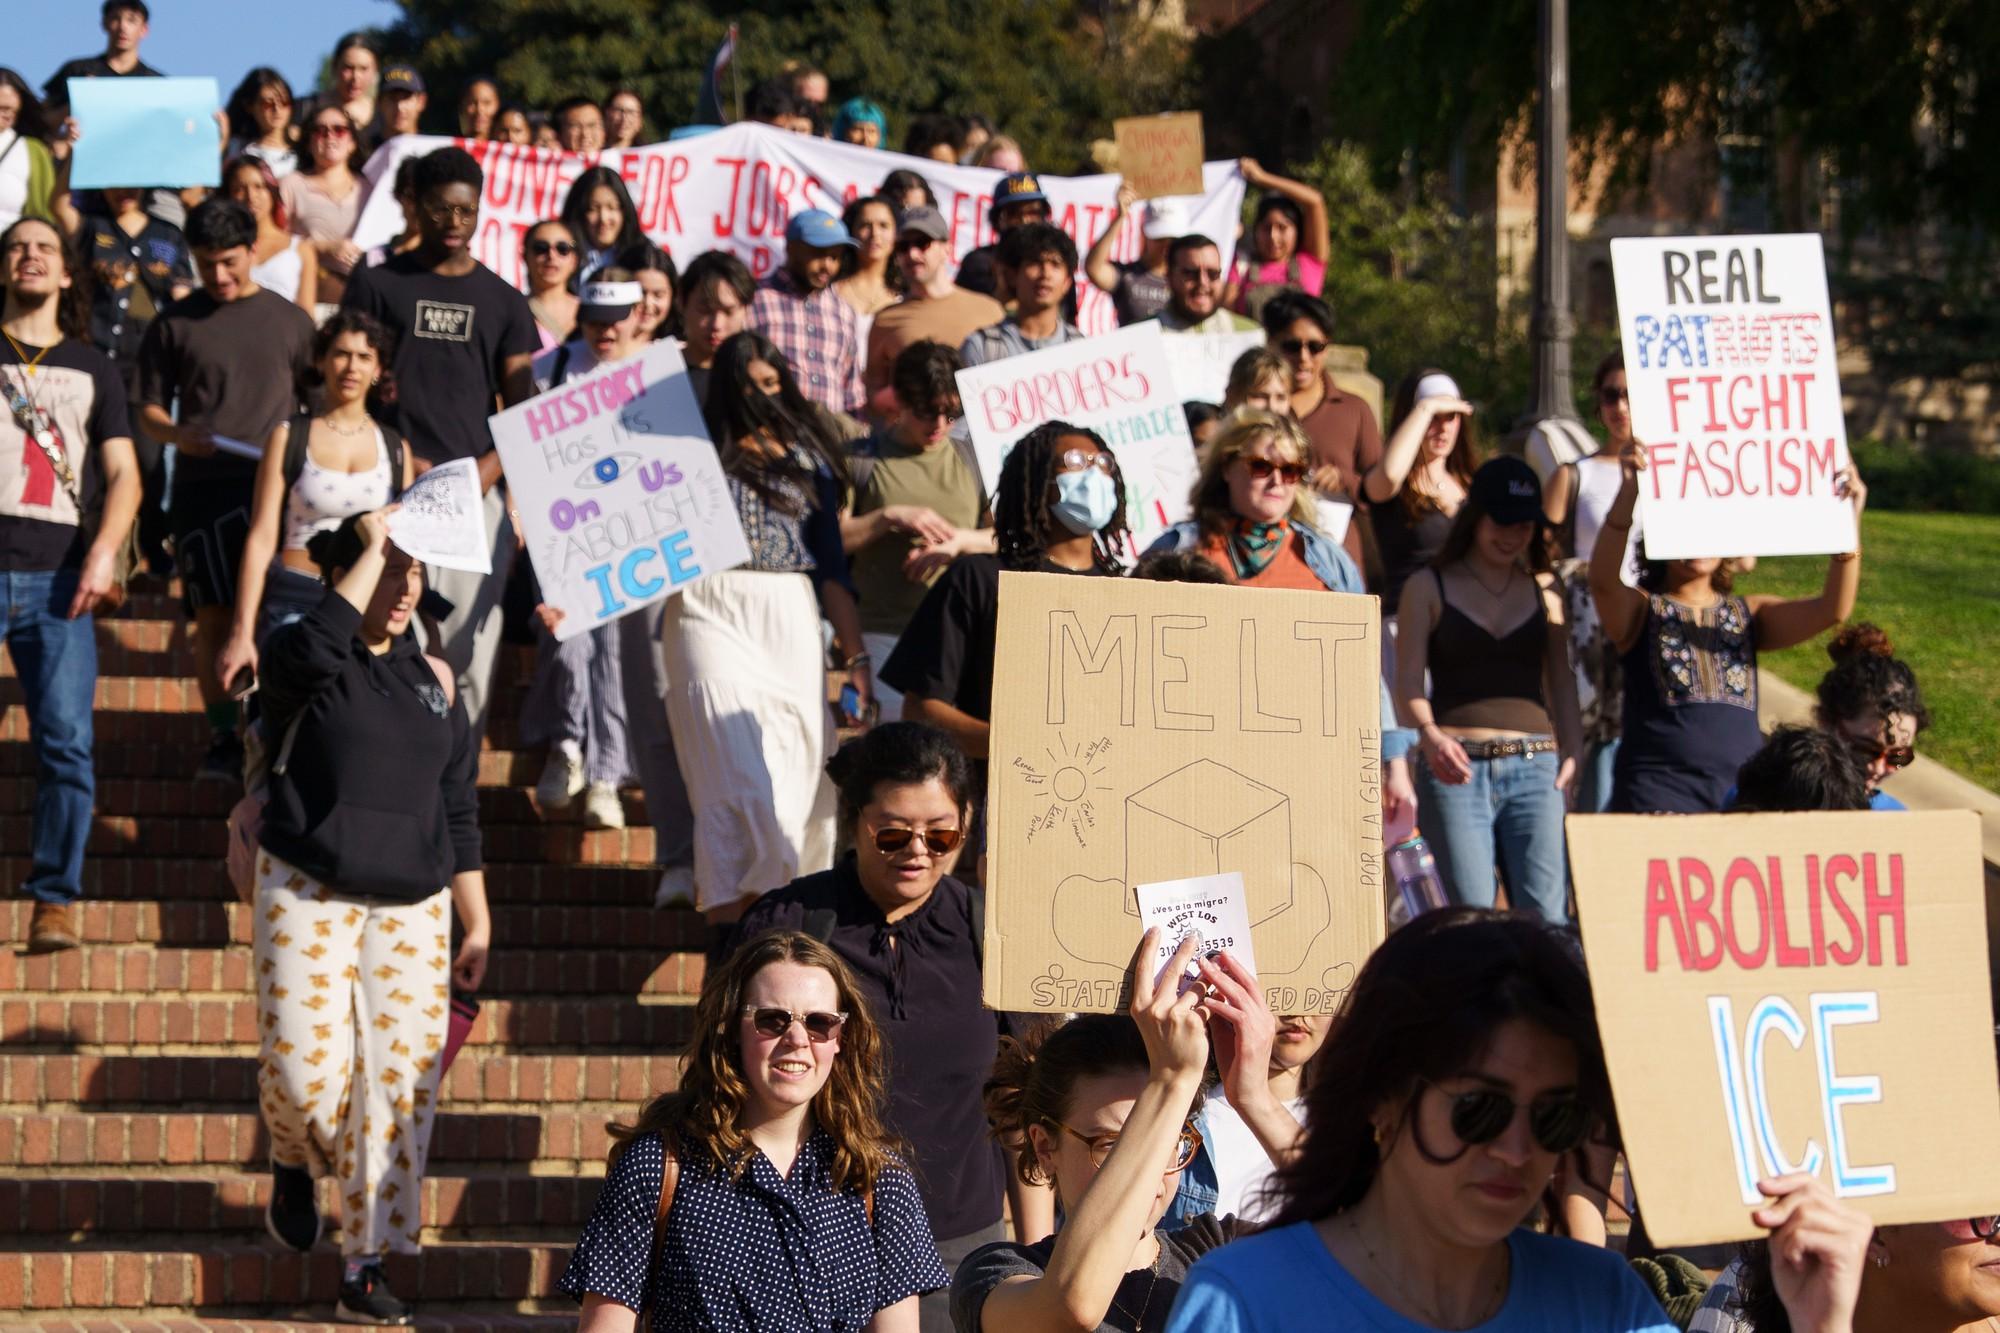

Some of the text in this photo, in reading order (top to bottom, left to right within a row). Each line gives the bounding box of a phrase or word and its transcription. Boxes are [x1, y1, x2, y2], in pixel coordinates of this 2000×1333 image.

[620, 154, 689, 235] FOR
[1151, 151, 1174, 168] LA
[1663, 247, 1781, 305] REAL
[1634, 313, 1821, 369] PATRIOTS
[524, 359, 648, 442] HISTORY
[981, 352, 1149, 433] BORDERS
[1667, 373, 1816, 433] FIGHT
[542, 433, 599, 473] Has
[1647, 437, 1841, 499] FASCISM
[550, 459, 684, 531] On Us
[563, 483, 699, 574] ABOLISH
[585, 530, 701, 619] ICE
[1047, 609, 1369, 737] MELT
[1359, 727, 1383, 887] POR LA GENTE
[1152, 905, 1173, 915] ¿Ves
[1194, 896, 1228, 909] migra?
[1167, 910, 1218, 929] WEST LOS
[1645, 852, 1908, 972] ABOLISH
[1031, 975, 1128, 1009] STATE
[1707, 991, 1896, 1206] ICE
